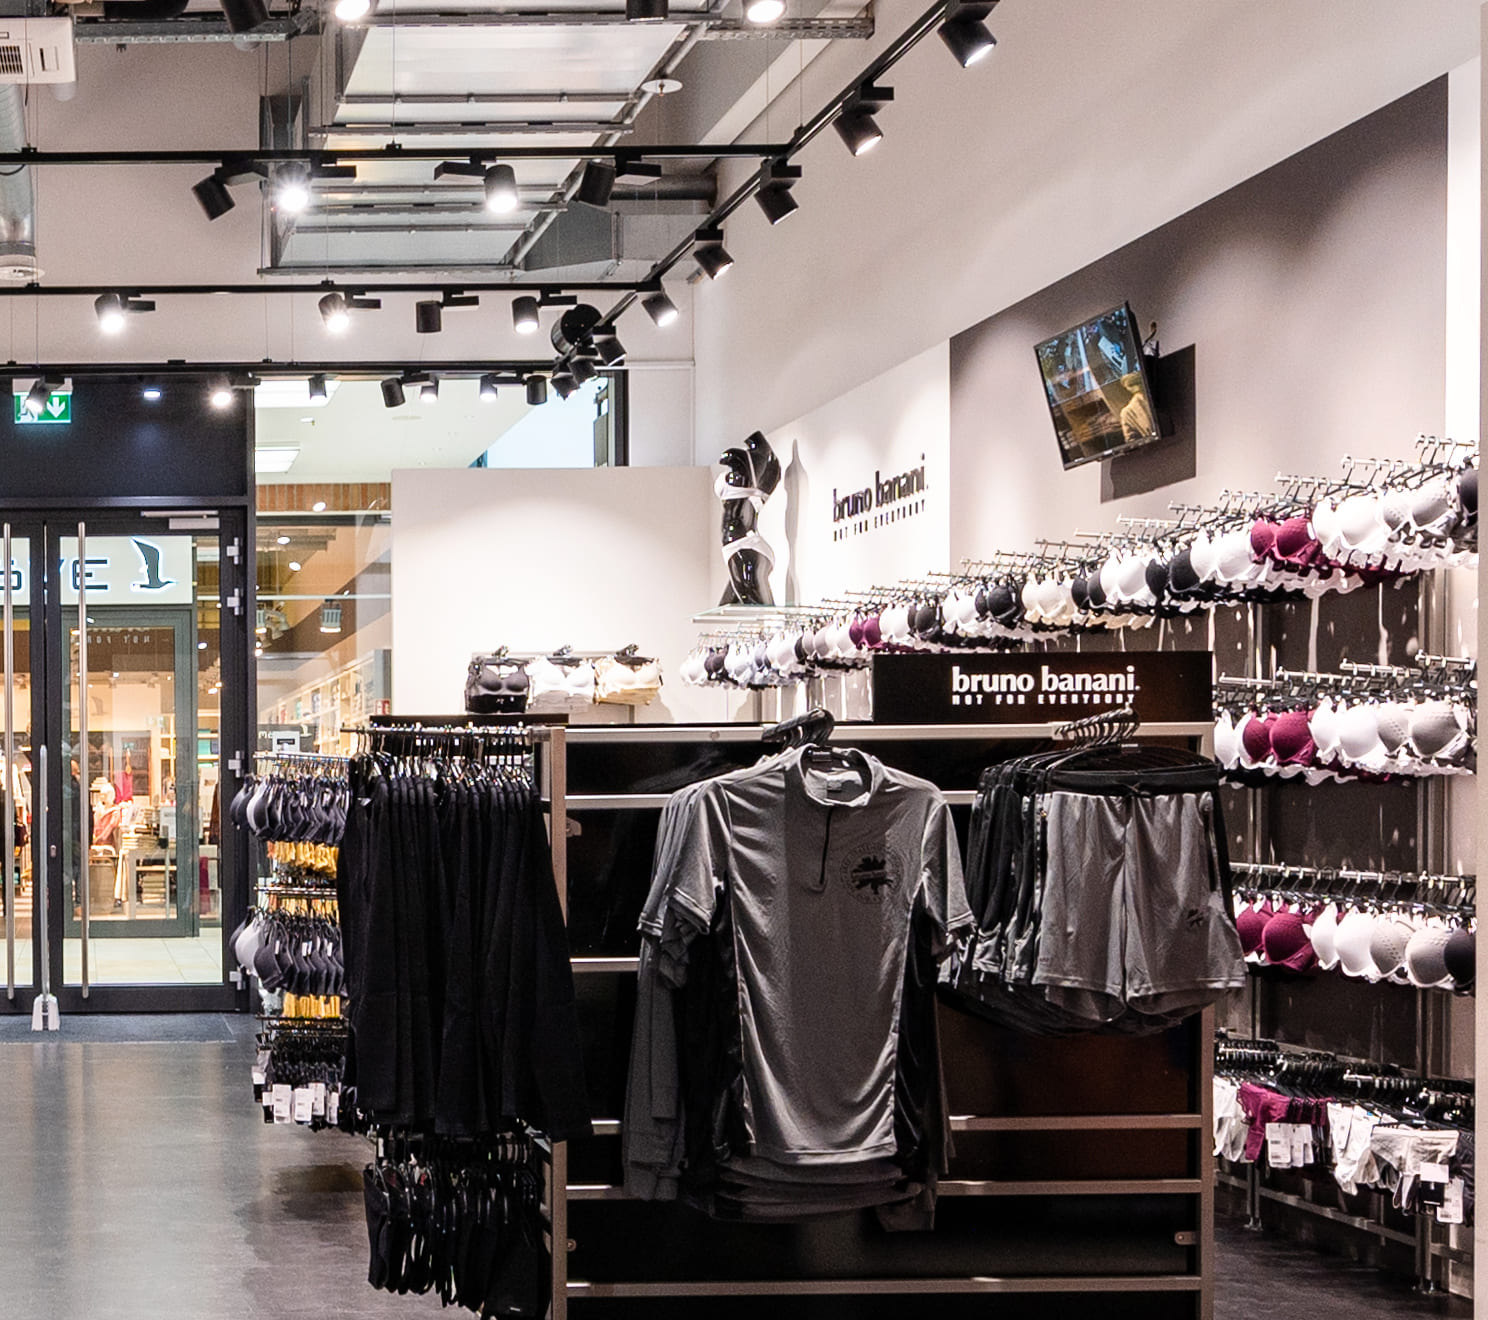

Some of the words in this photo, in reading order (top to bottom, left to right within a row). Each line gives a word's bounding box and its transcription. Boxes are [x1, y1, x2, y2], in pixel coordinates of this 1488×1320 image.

[833, 488, 873, 522] bruno
[952, 665, 1035, 693] bruno
[951, 694, 984, 705] NOT
[995, 694, 1026, 705] FOR
[1038, 693, 1136, 705] EVERYBODY
